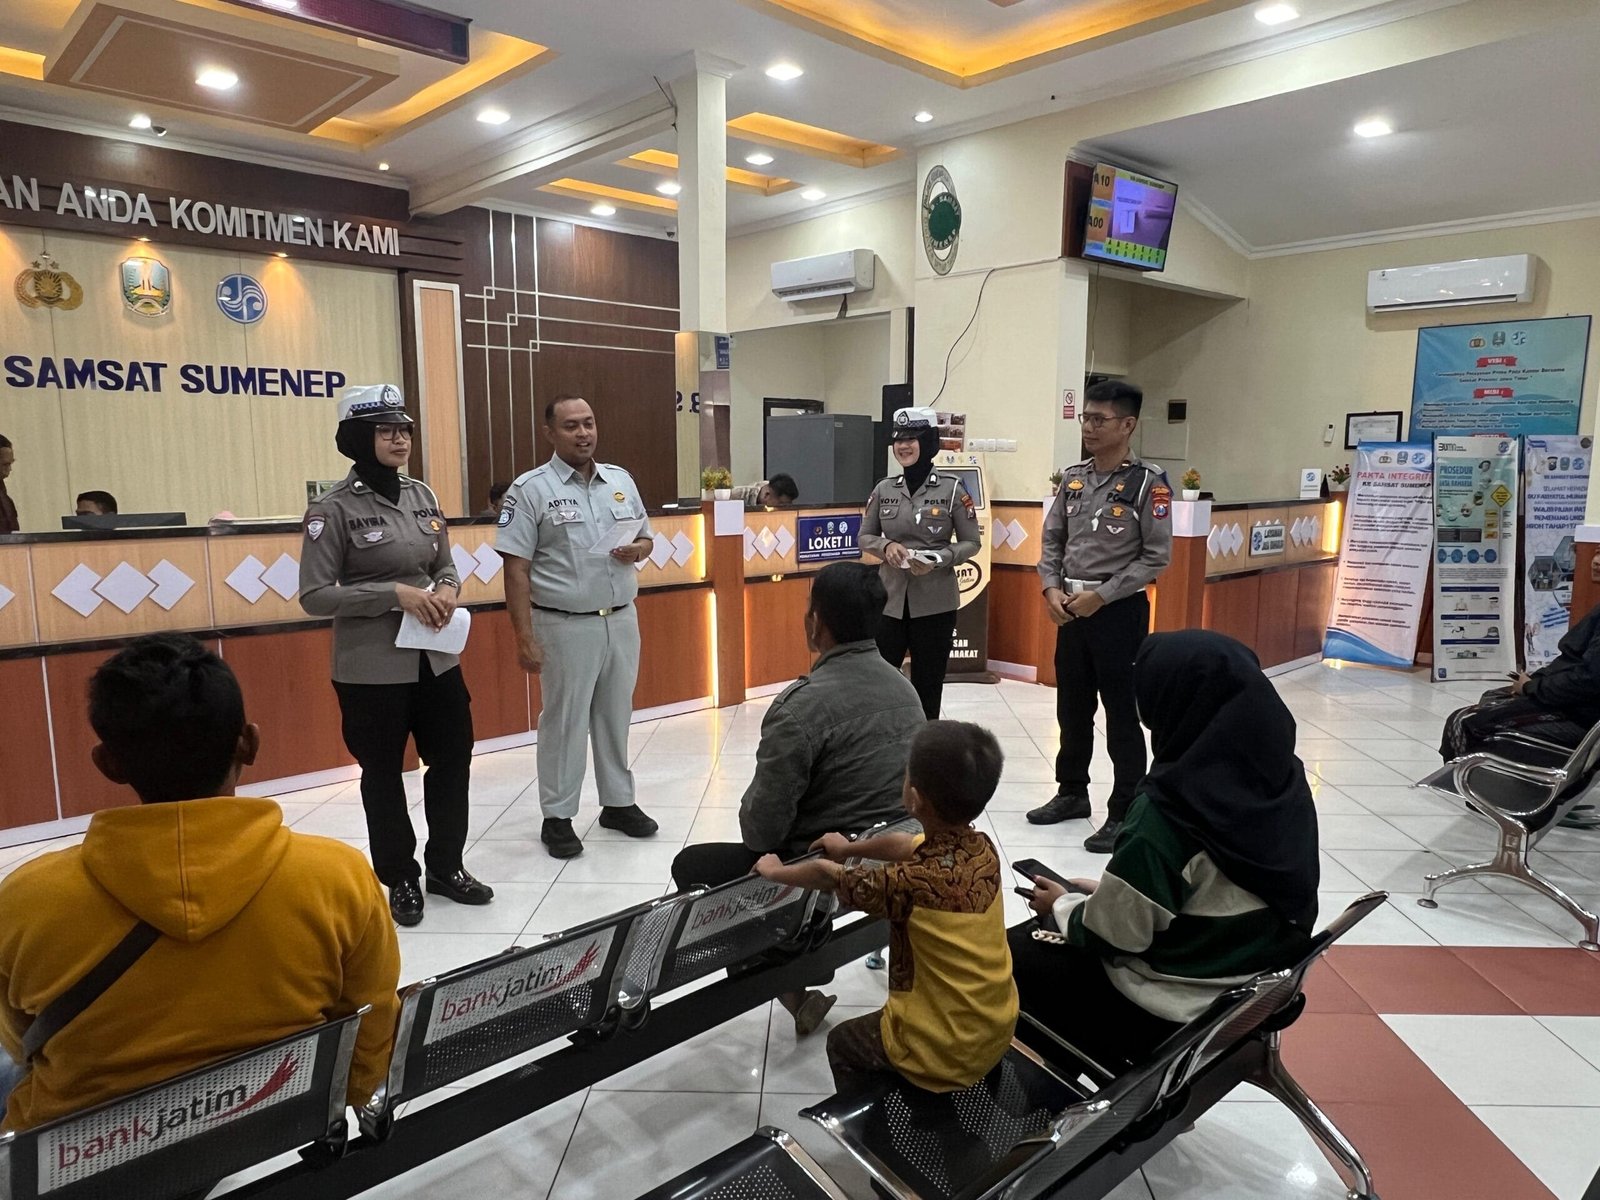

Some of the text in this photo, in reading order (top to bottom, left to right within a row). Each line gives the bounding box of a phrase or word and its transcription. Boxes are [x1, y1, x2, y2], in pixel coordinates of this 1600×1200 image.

[56, 182, 158, 227] ANDA
[169, 196, 324, 248] KOMITMEN
[333, 220, 400, 256] KAMI
[4, 355, 346, 398] SAMSAT SUMENEP
[1357, 471, 1385, 480] PAKTA
[548, 499, 578, 509] ADITYA
[808, 535, 852, 550] LOKET II
[441, 964, 563, 1023] bankjatim
[58, 1083, 248, 1170] bankjatim
